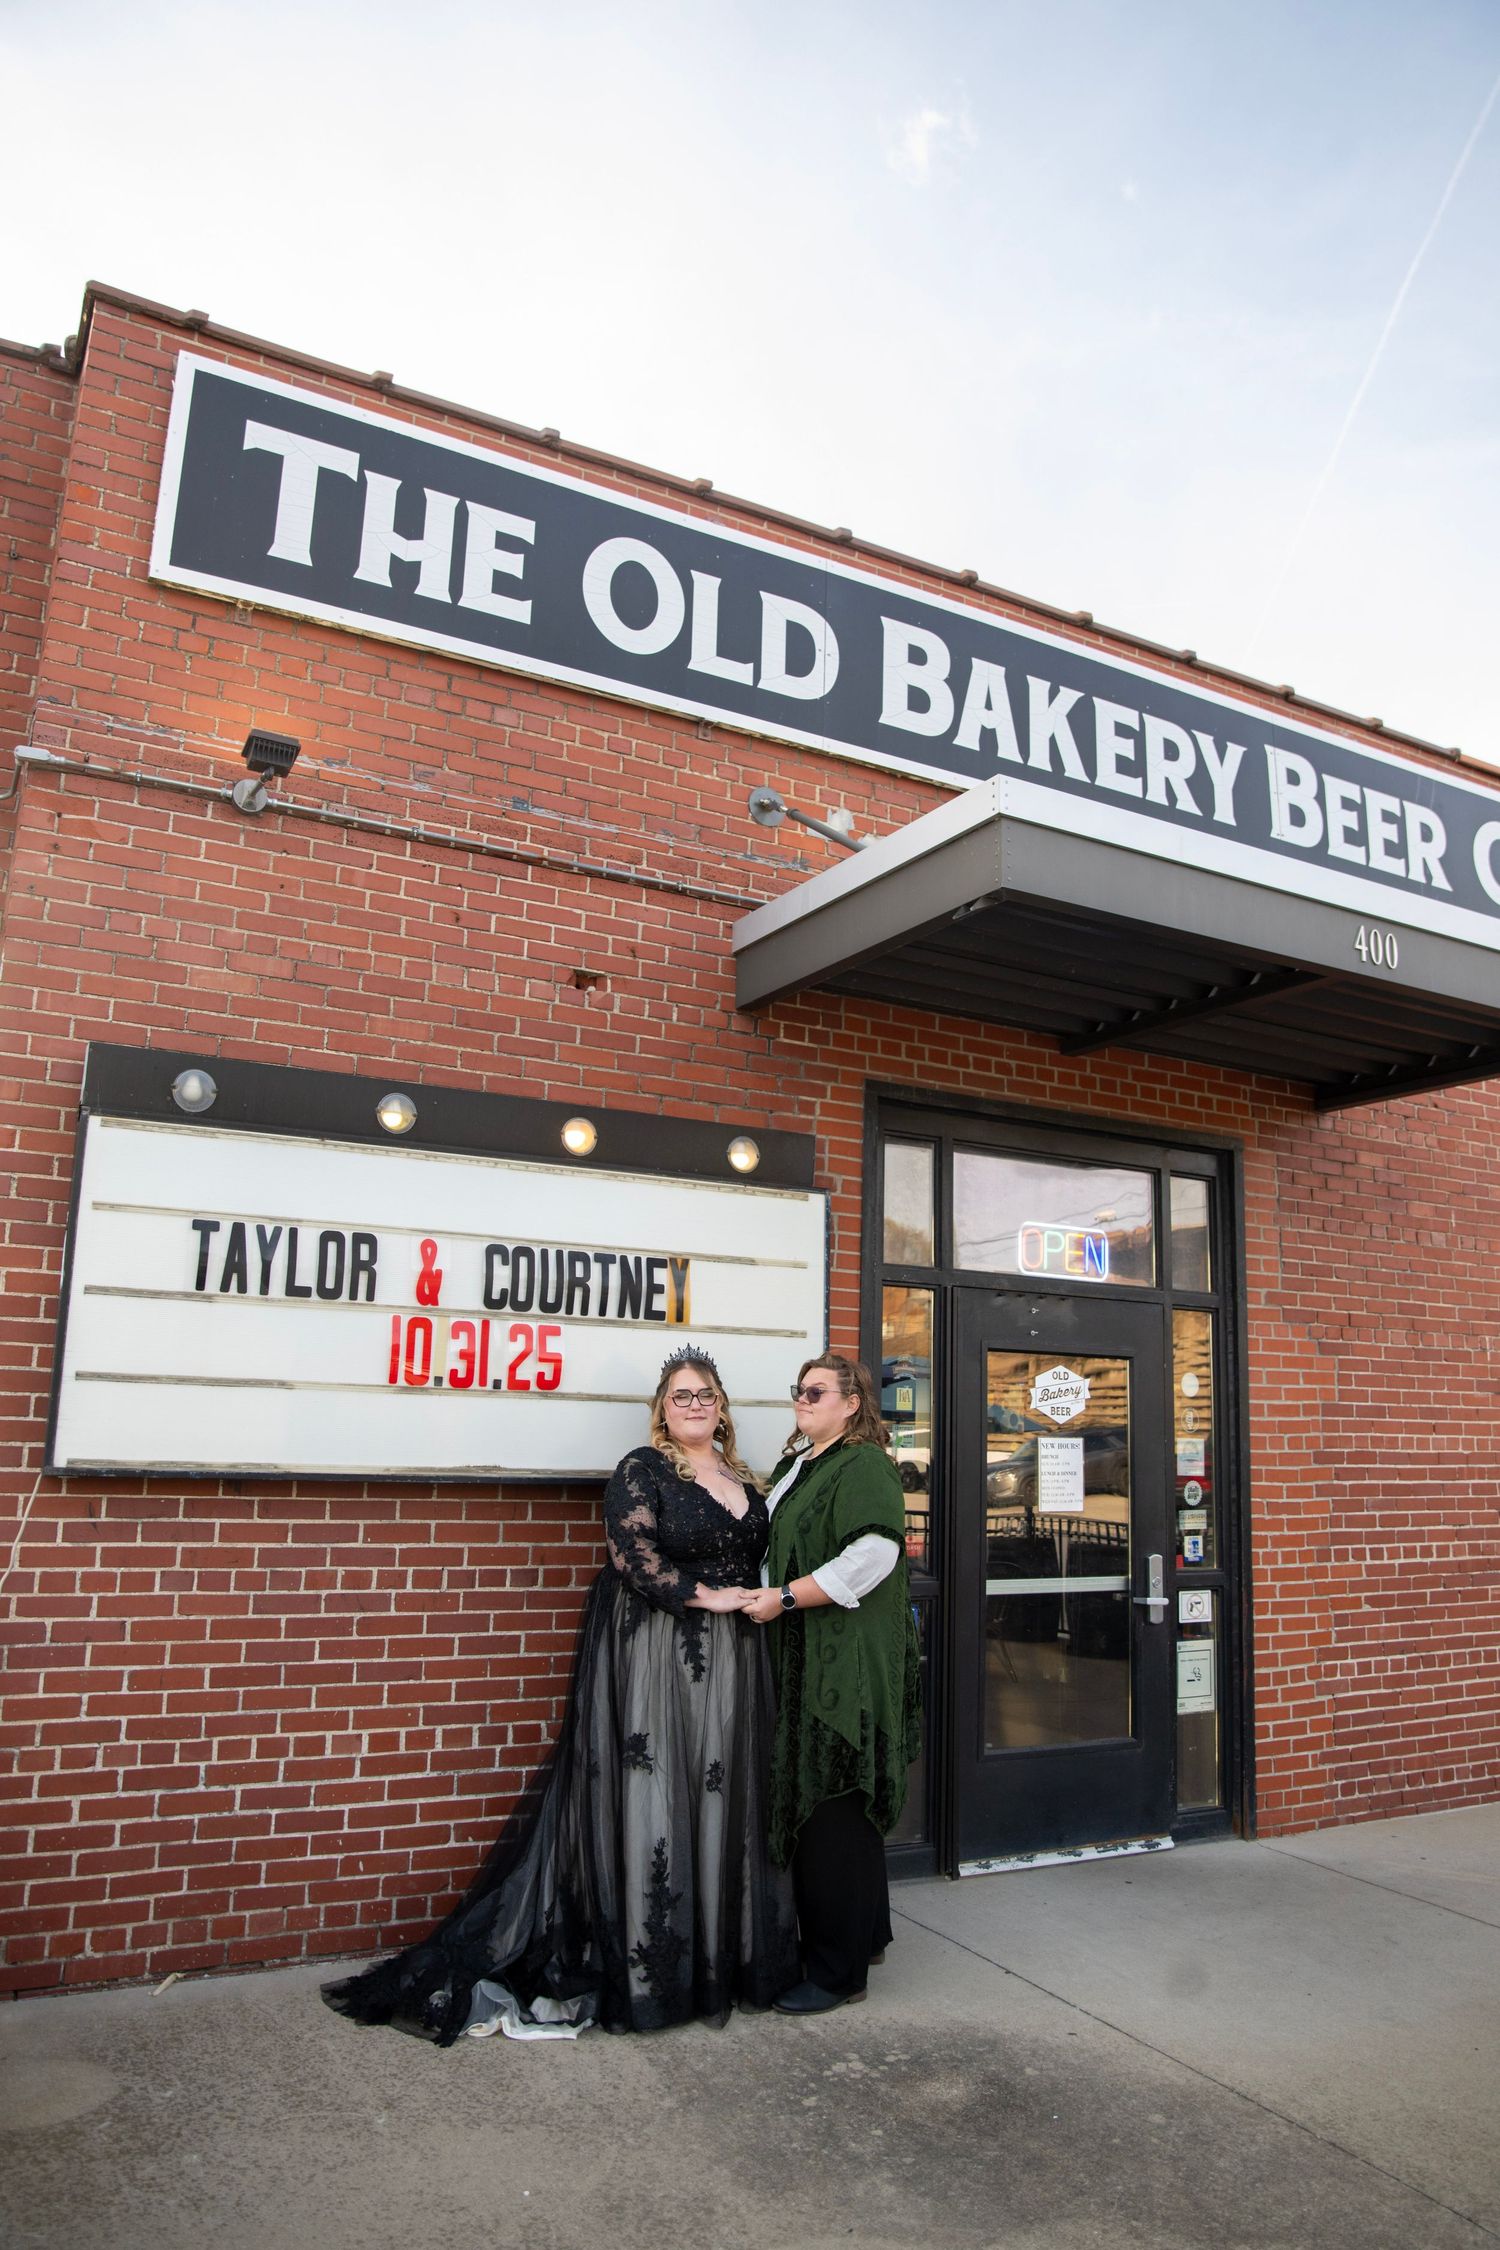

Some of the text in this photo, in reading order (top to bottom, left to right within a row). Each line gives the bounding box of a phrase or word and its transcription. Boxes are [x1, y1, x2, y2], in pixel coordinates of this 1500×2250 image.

[243, 419, 536, 625] THE
[582, 536, 840, 700] OLD
[878, 616, 1248, 826] BAKERY
[1264, 744, 1454, 893] BEER
[1354, 925, 1398, 969] 400
[192, 1219, 690, 1323] TAYLOR & COURTNEY
[1022, 1227, 1105, 1275] OPEN
[388, 1314, 563, 1391] 10.31.25
[1038, 1385, 1083, 1403] Bakery
[1051, 1371, 1070, 1381] OLD
[1050, 1406, 1071, 1416] BEER
[1041, 1442, 1056, 1450] NEW
